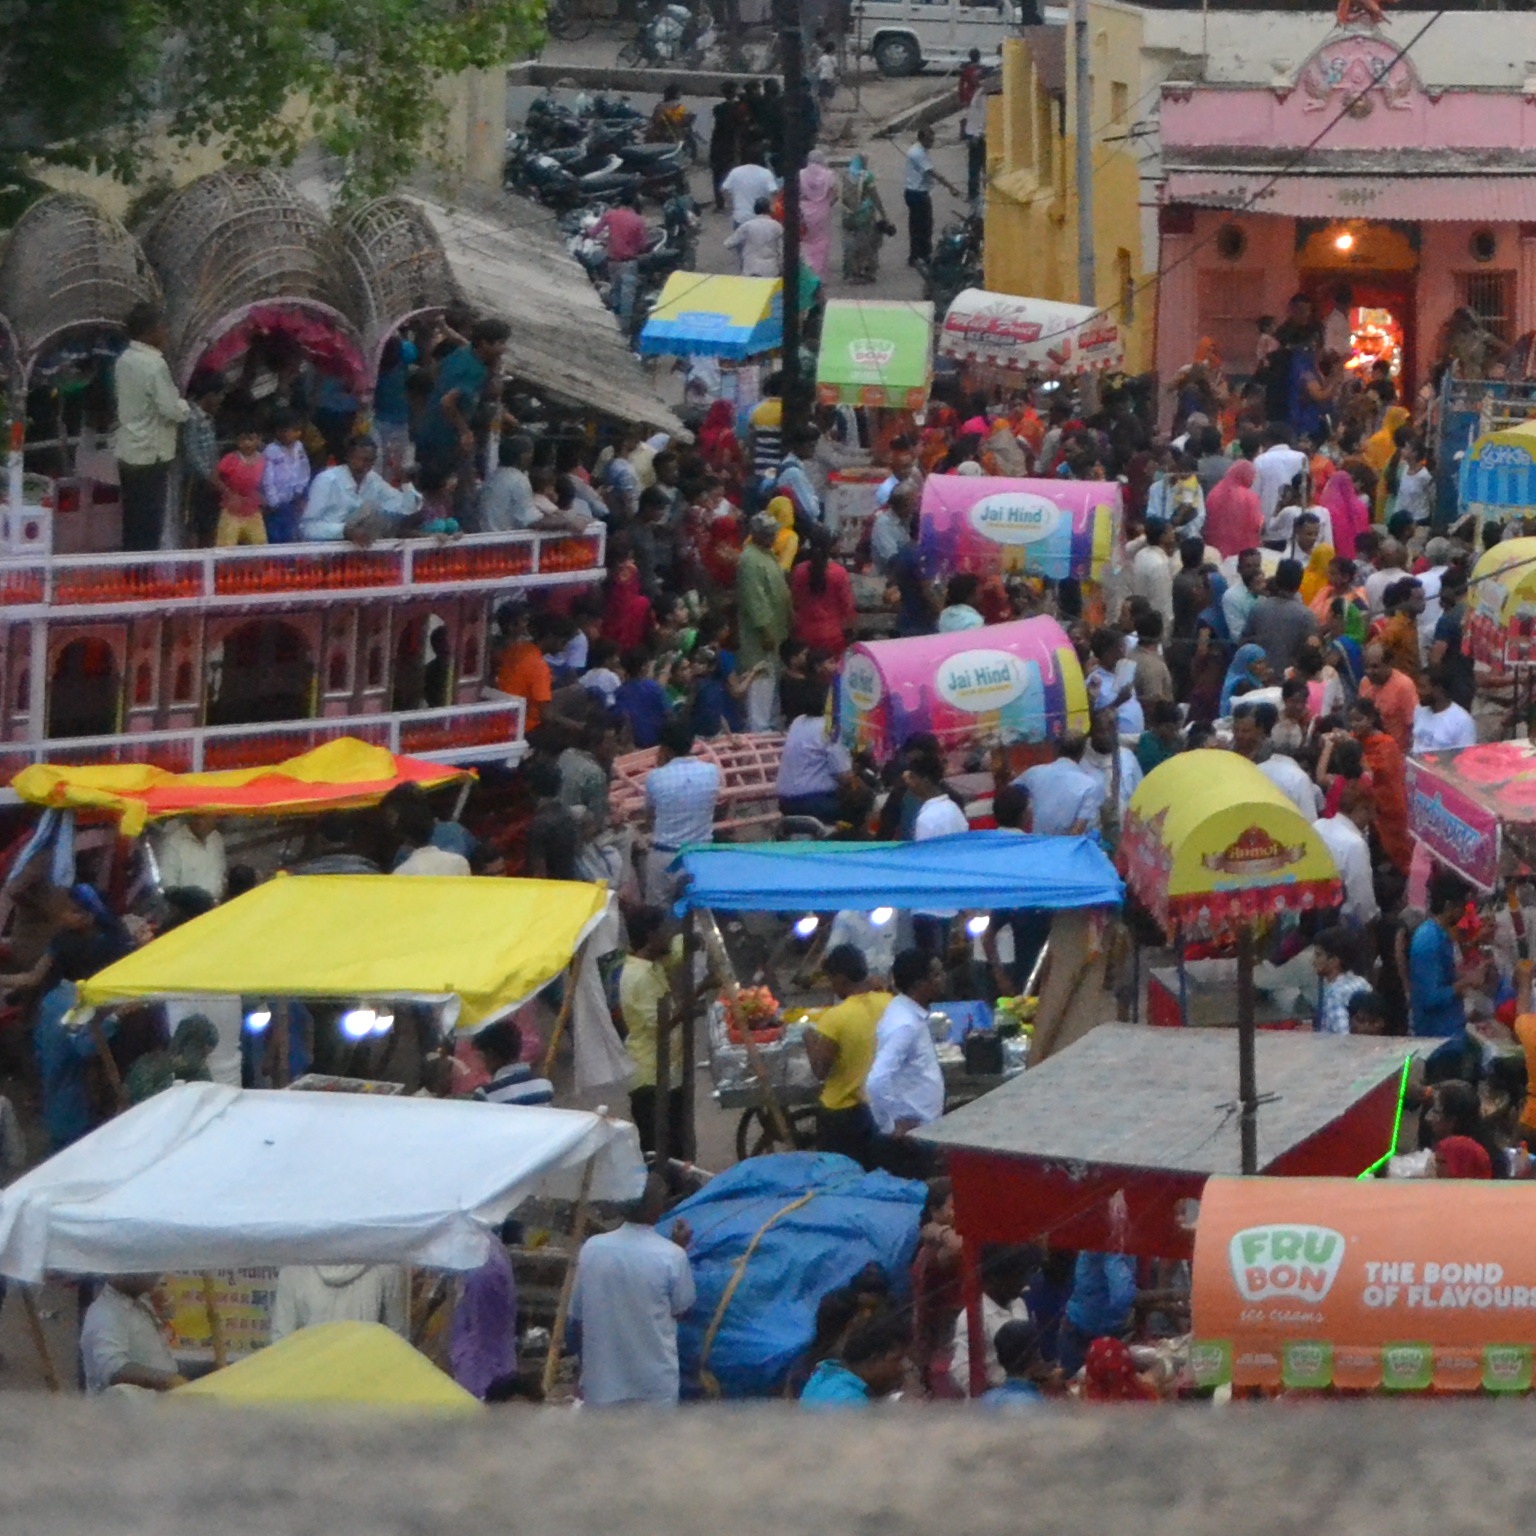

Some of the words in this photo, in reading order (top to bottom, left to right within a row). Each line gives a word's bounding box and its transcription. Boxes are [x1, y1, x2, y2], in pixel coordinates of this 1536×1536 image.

[980, 506, 1004, 522] Jai
[1007, 507, 1043, 523] Hind
[948, 671, 972, 691] Jai
[975, 664, 1012, 686] Hind
[1240, 1230, 1338, 1265] FRU
[1243, 1265, 1328, 1294] BON
[1363, 1261, 1414, 1284] THE
[1423, 1262, 1504, 1285] BOND
[1363, 1286, 1400, 1308] OF
